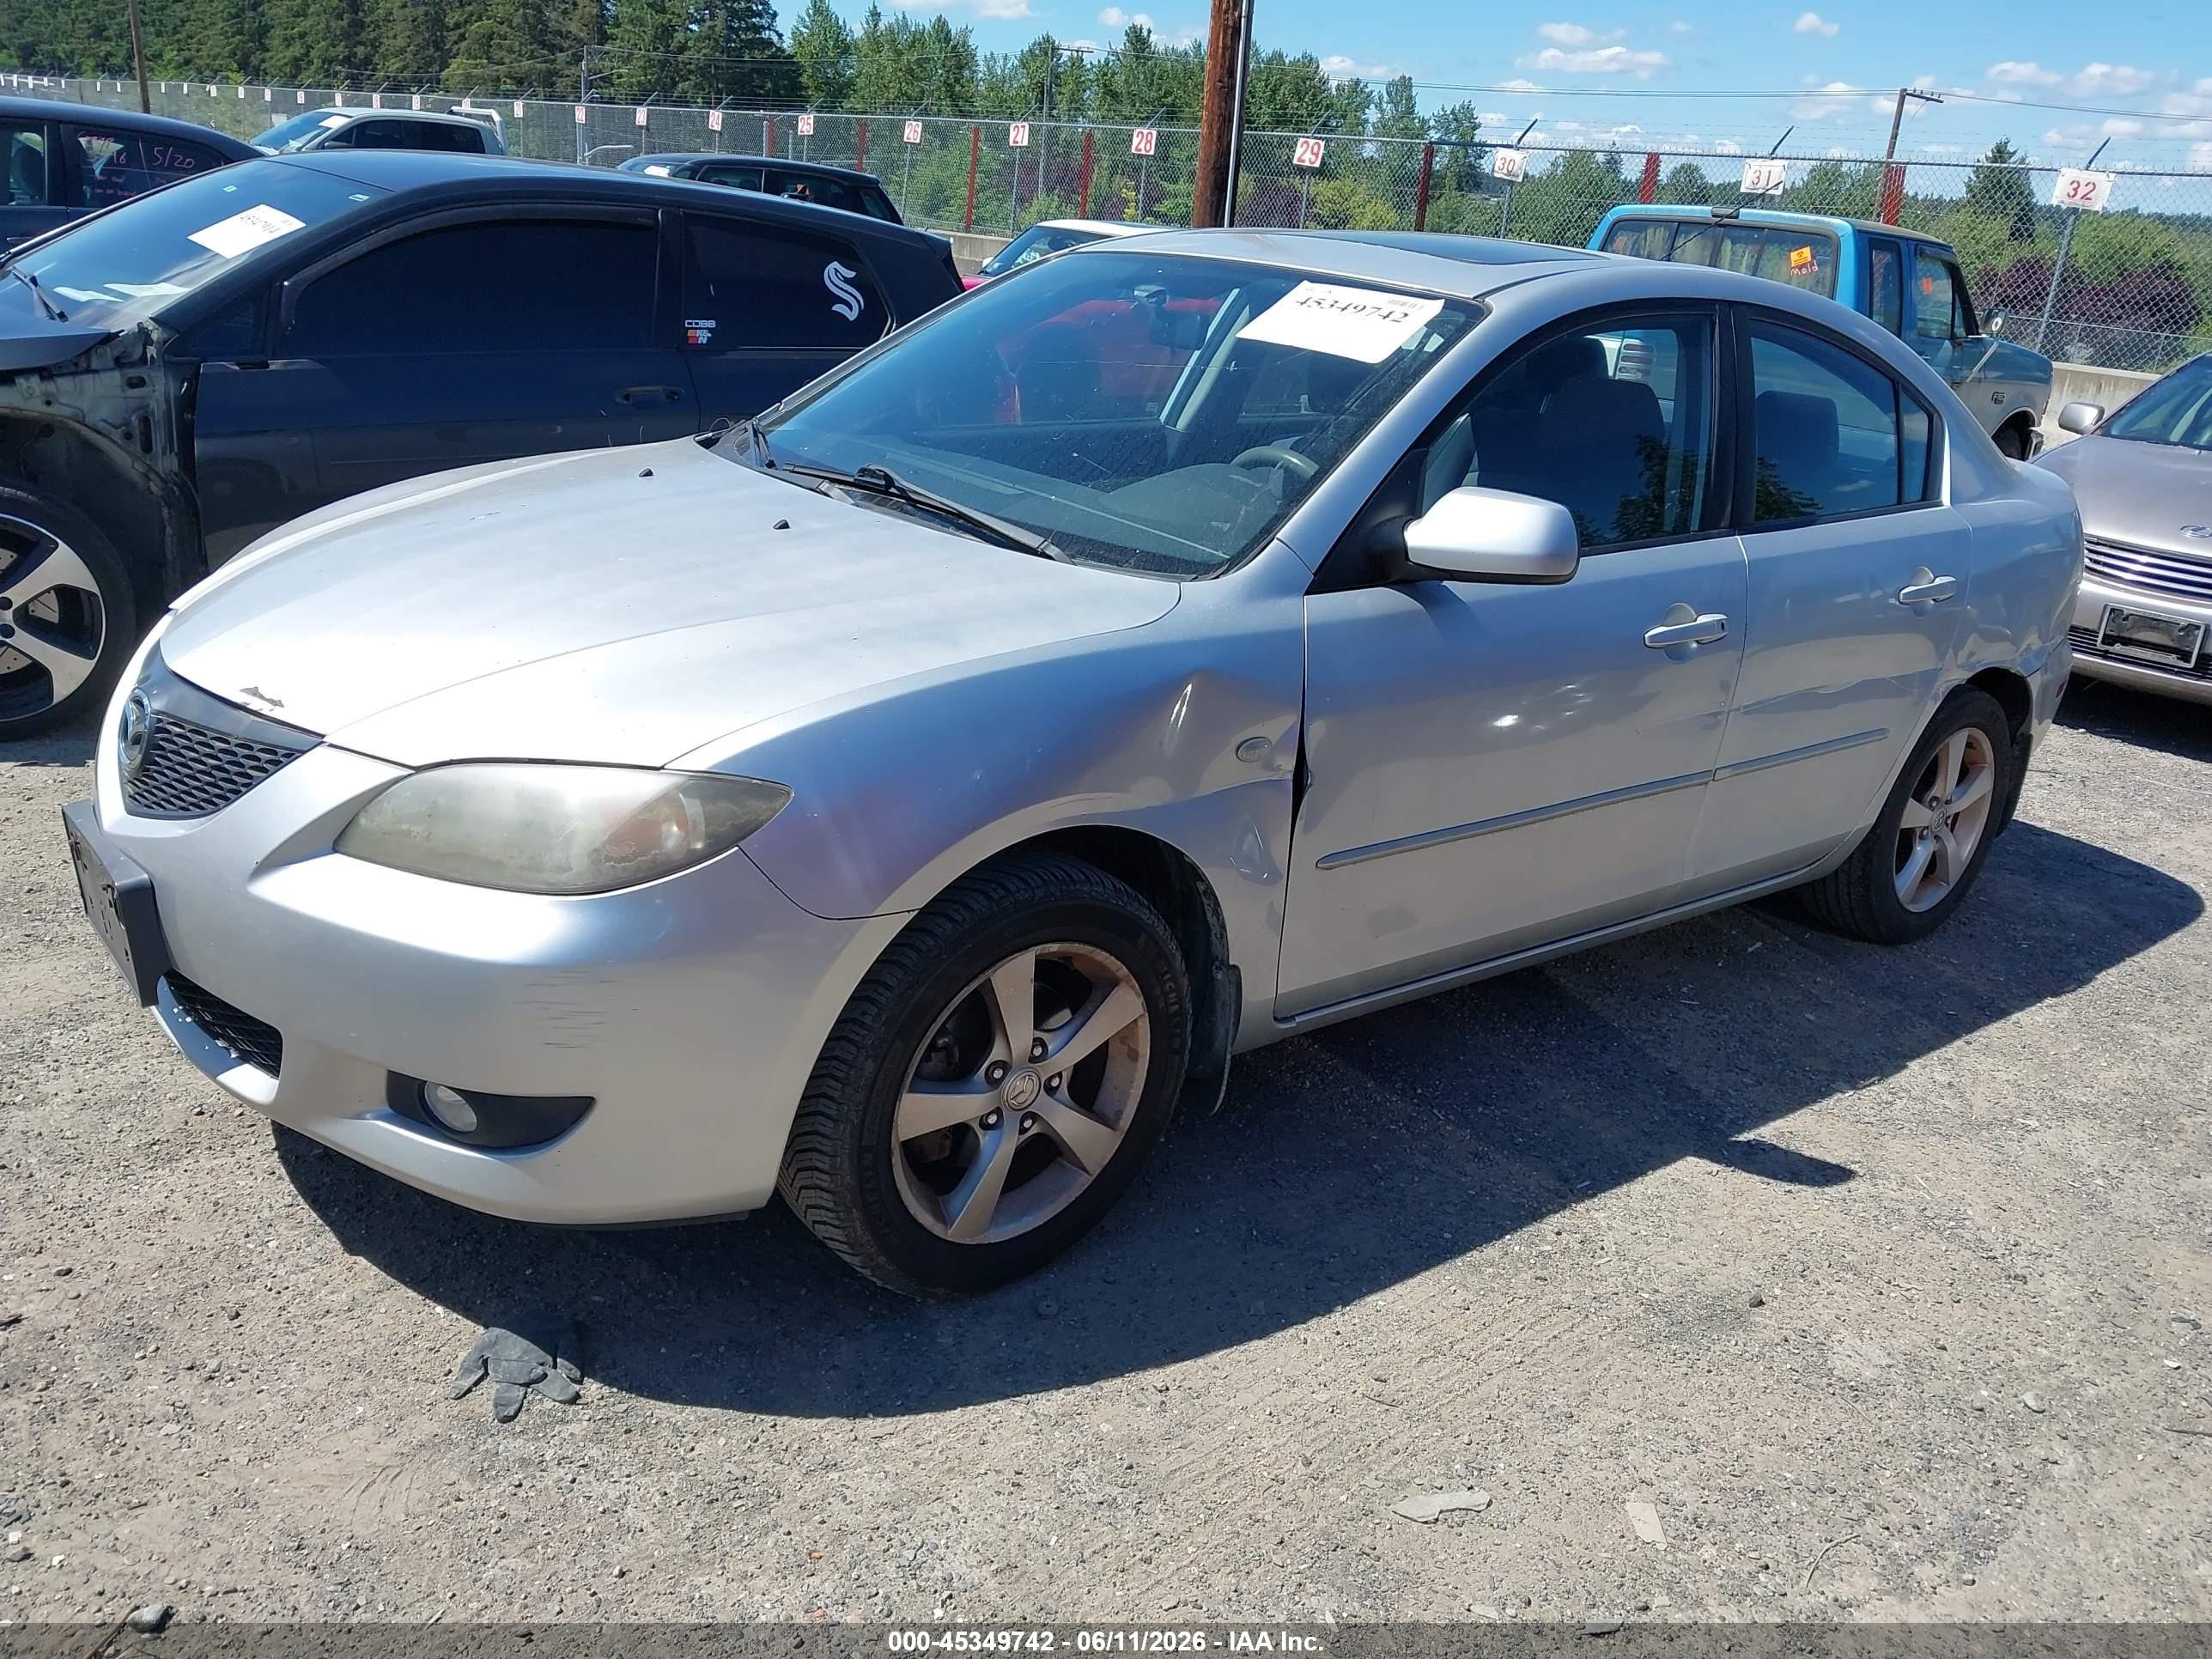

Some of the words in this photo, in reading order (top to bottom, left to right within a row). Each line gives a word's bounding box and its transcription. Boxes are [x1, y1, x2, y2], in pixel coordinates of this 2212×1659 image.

[576, 107, 585, 122] 22
[637, 108, 647, 125] 23
[710, 112, 721, 128] 24
[799, 117, 812, 134] 25
[906, 122, 921, 142] 26
[1012, 124, 1027, 144] 27
[1133, 131, 1154, 153] 28
[152, 146, 196, 169] 5/20
[1296, 140, 1322, 165] 29
[1498, 156, 1516, 173] 30
[1751, 169, 1772, 187] 31
[2067, 179, 2097, 201] 32
[1790, 259, 1819, 276] Mold
[1294, 295, 1410, 324] 45349742
[684, 319, 716, 328] COBB
